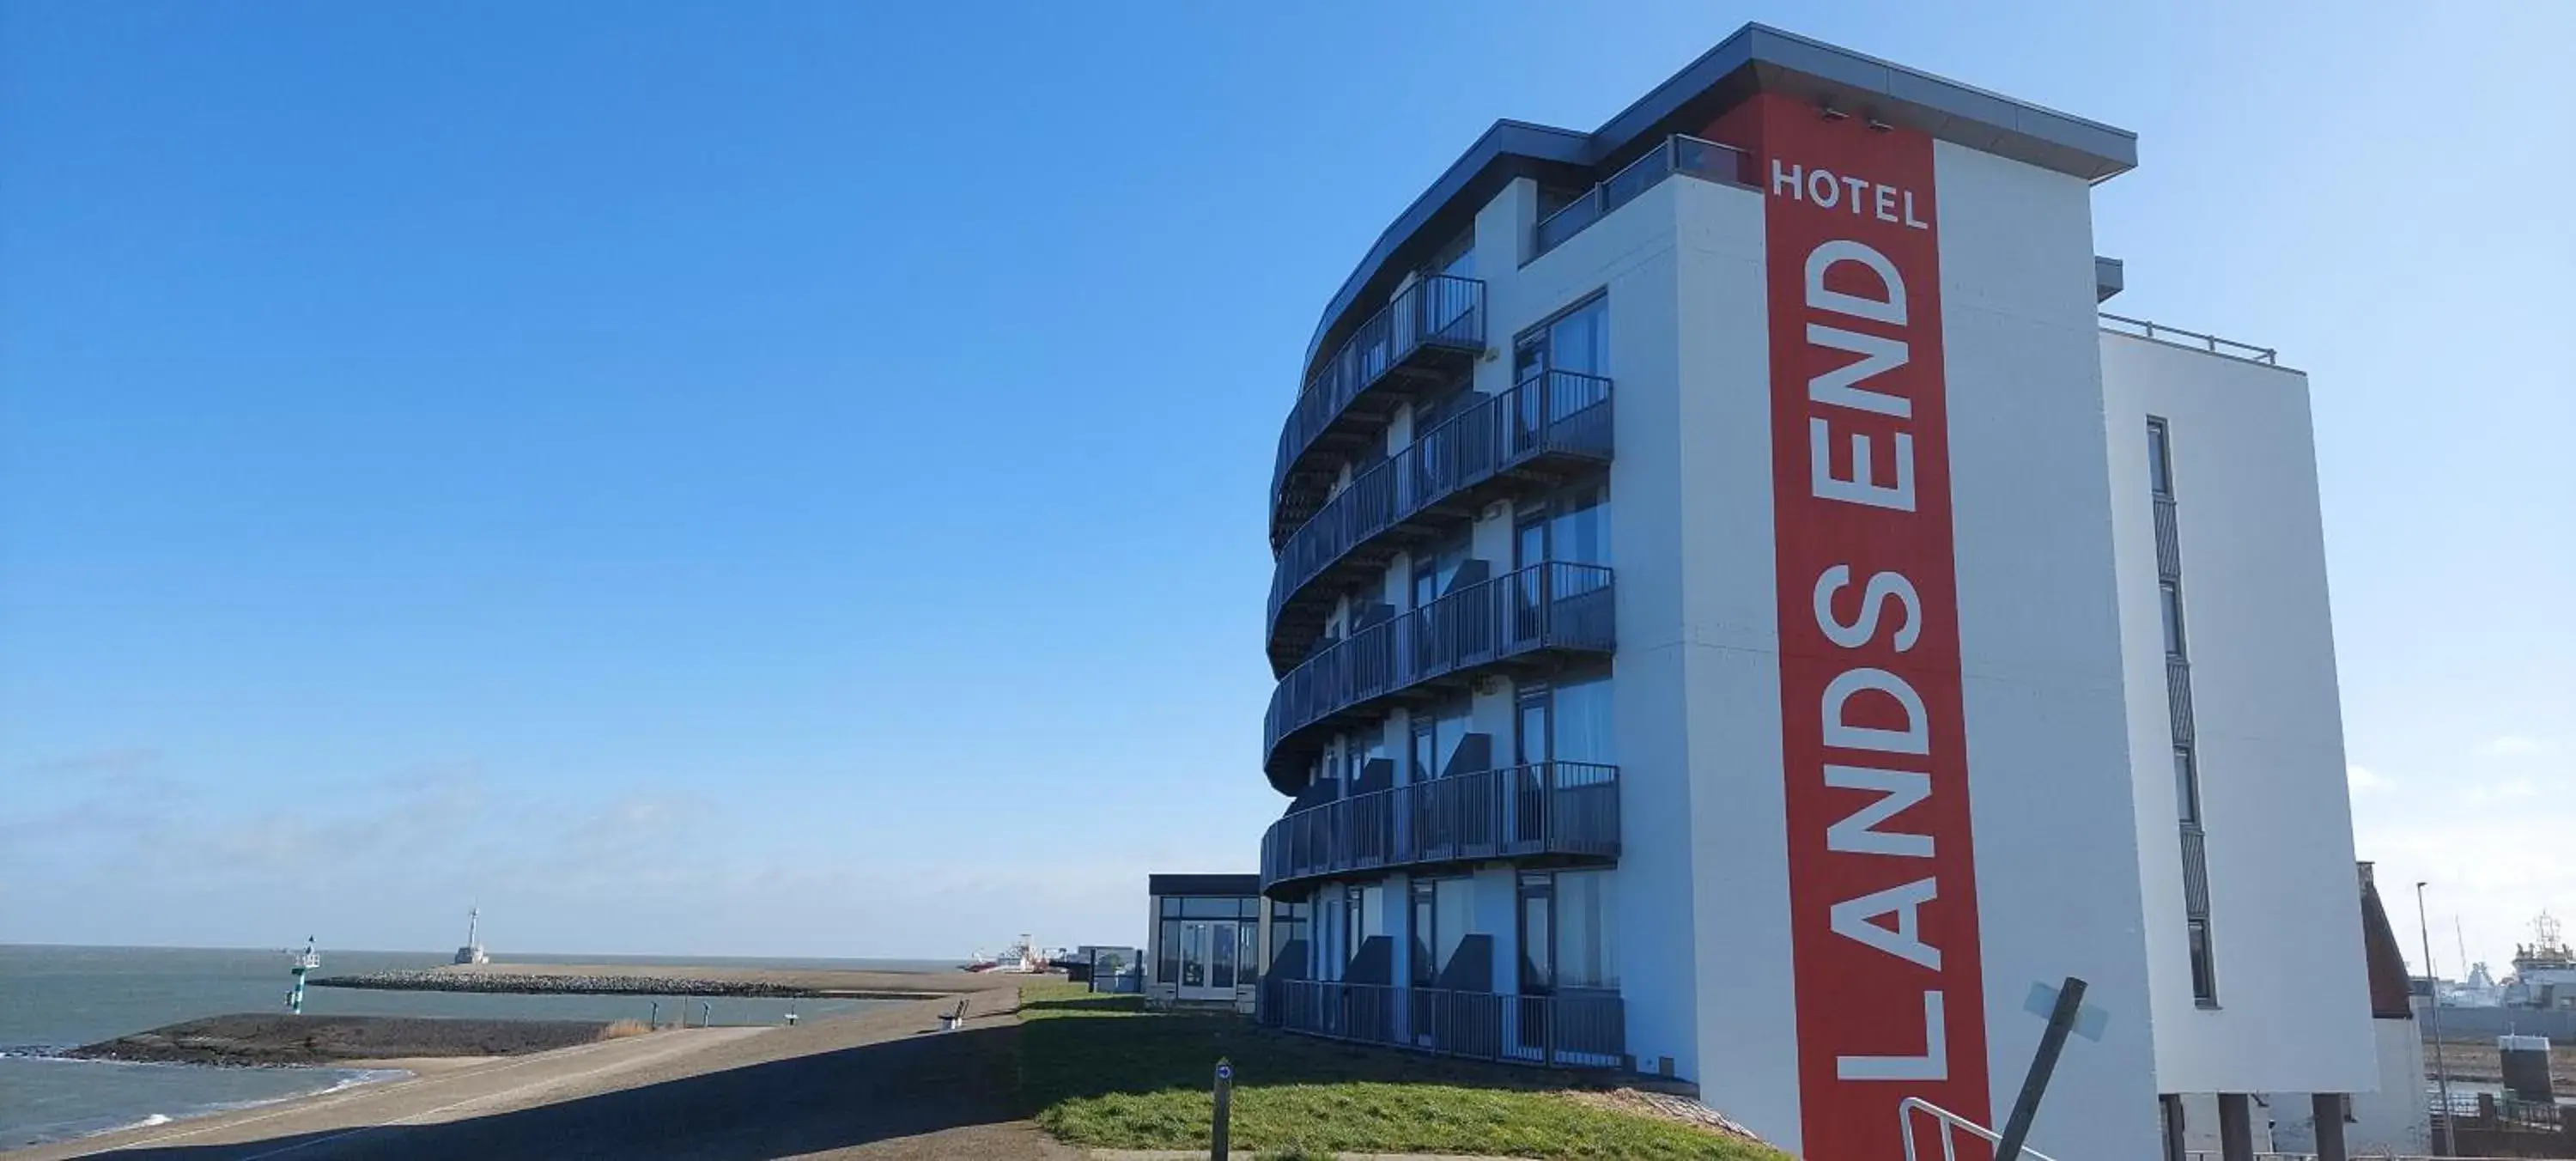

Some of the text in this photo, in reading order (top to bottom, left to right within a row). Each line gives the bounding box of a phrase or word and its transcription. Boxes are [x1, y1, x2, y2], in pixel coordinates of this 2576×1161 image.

[1772, 159, 1928, 229] HOTEL
[1805, 240, 1947, 1080] LANDS END
